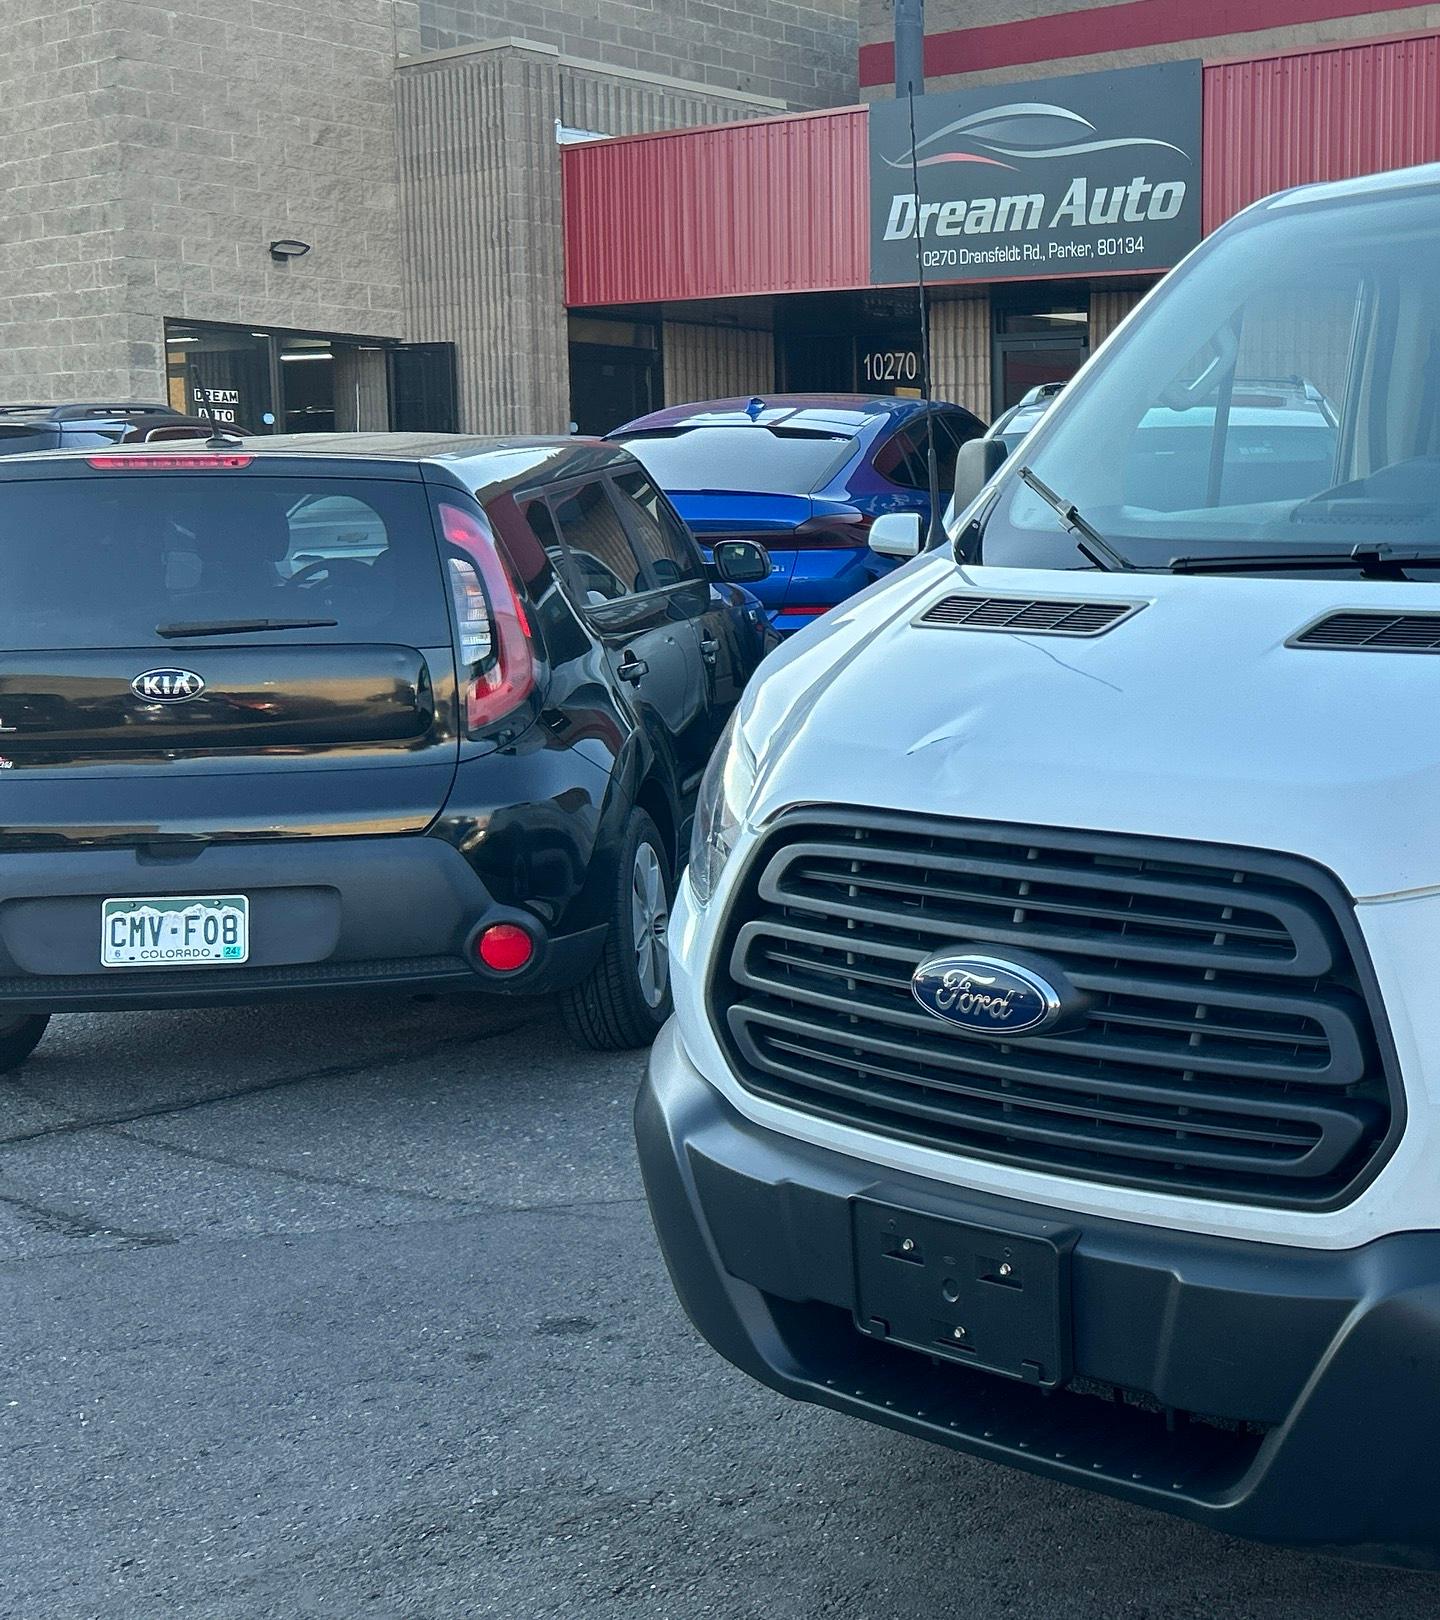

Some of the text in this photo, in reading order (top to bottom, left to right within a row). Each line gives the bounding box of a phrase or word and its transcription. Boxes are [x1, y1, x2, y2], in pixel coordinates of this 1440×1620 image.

[883, 175, 1187, 241] Dream Auto
[916, 236, 1145, 267] 0270 Dransfeldt Rd., Parker, 80134
[863, 351, 917, 381] 10270
[195, 389, 238, 403] DREAM
[143, 674, 192, 695] KIA
[140, 948, 211, 960] COLORADO
[935, 968, 1017, 1021] Ford
